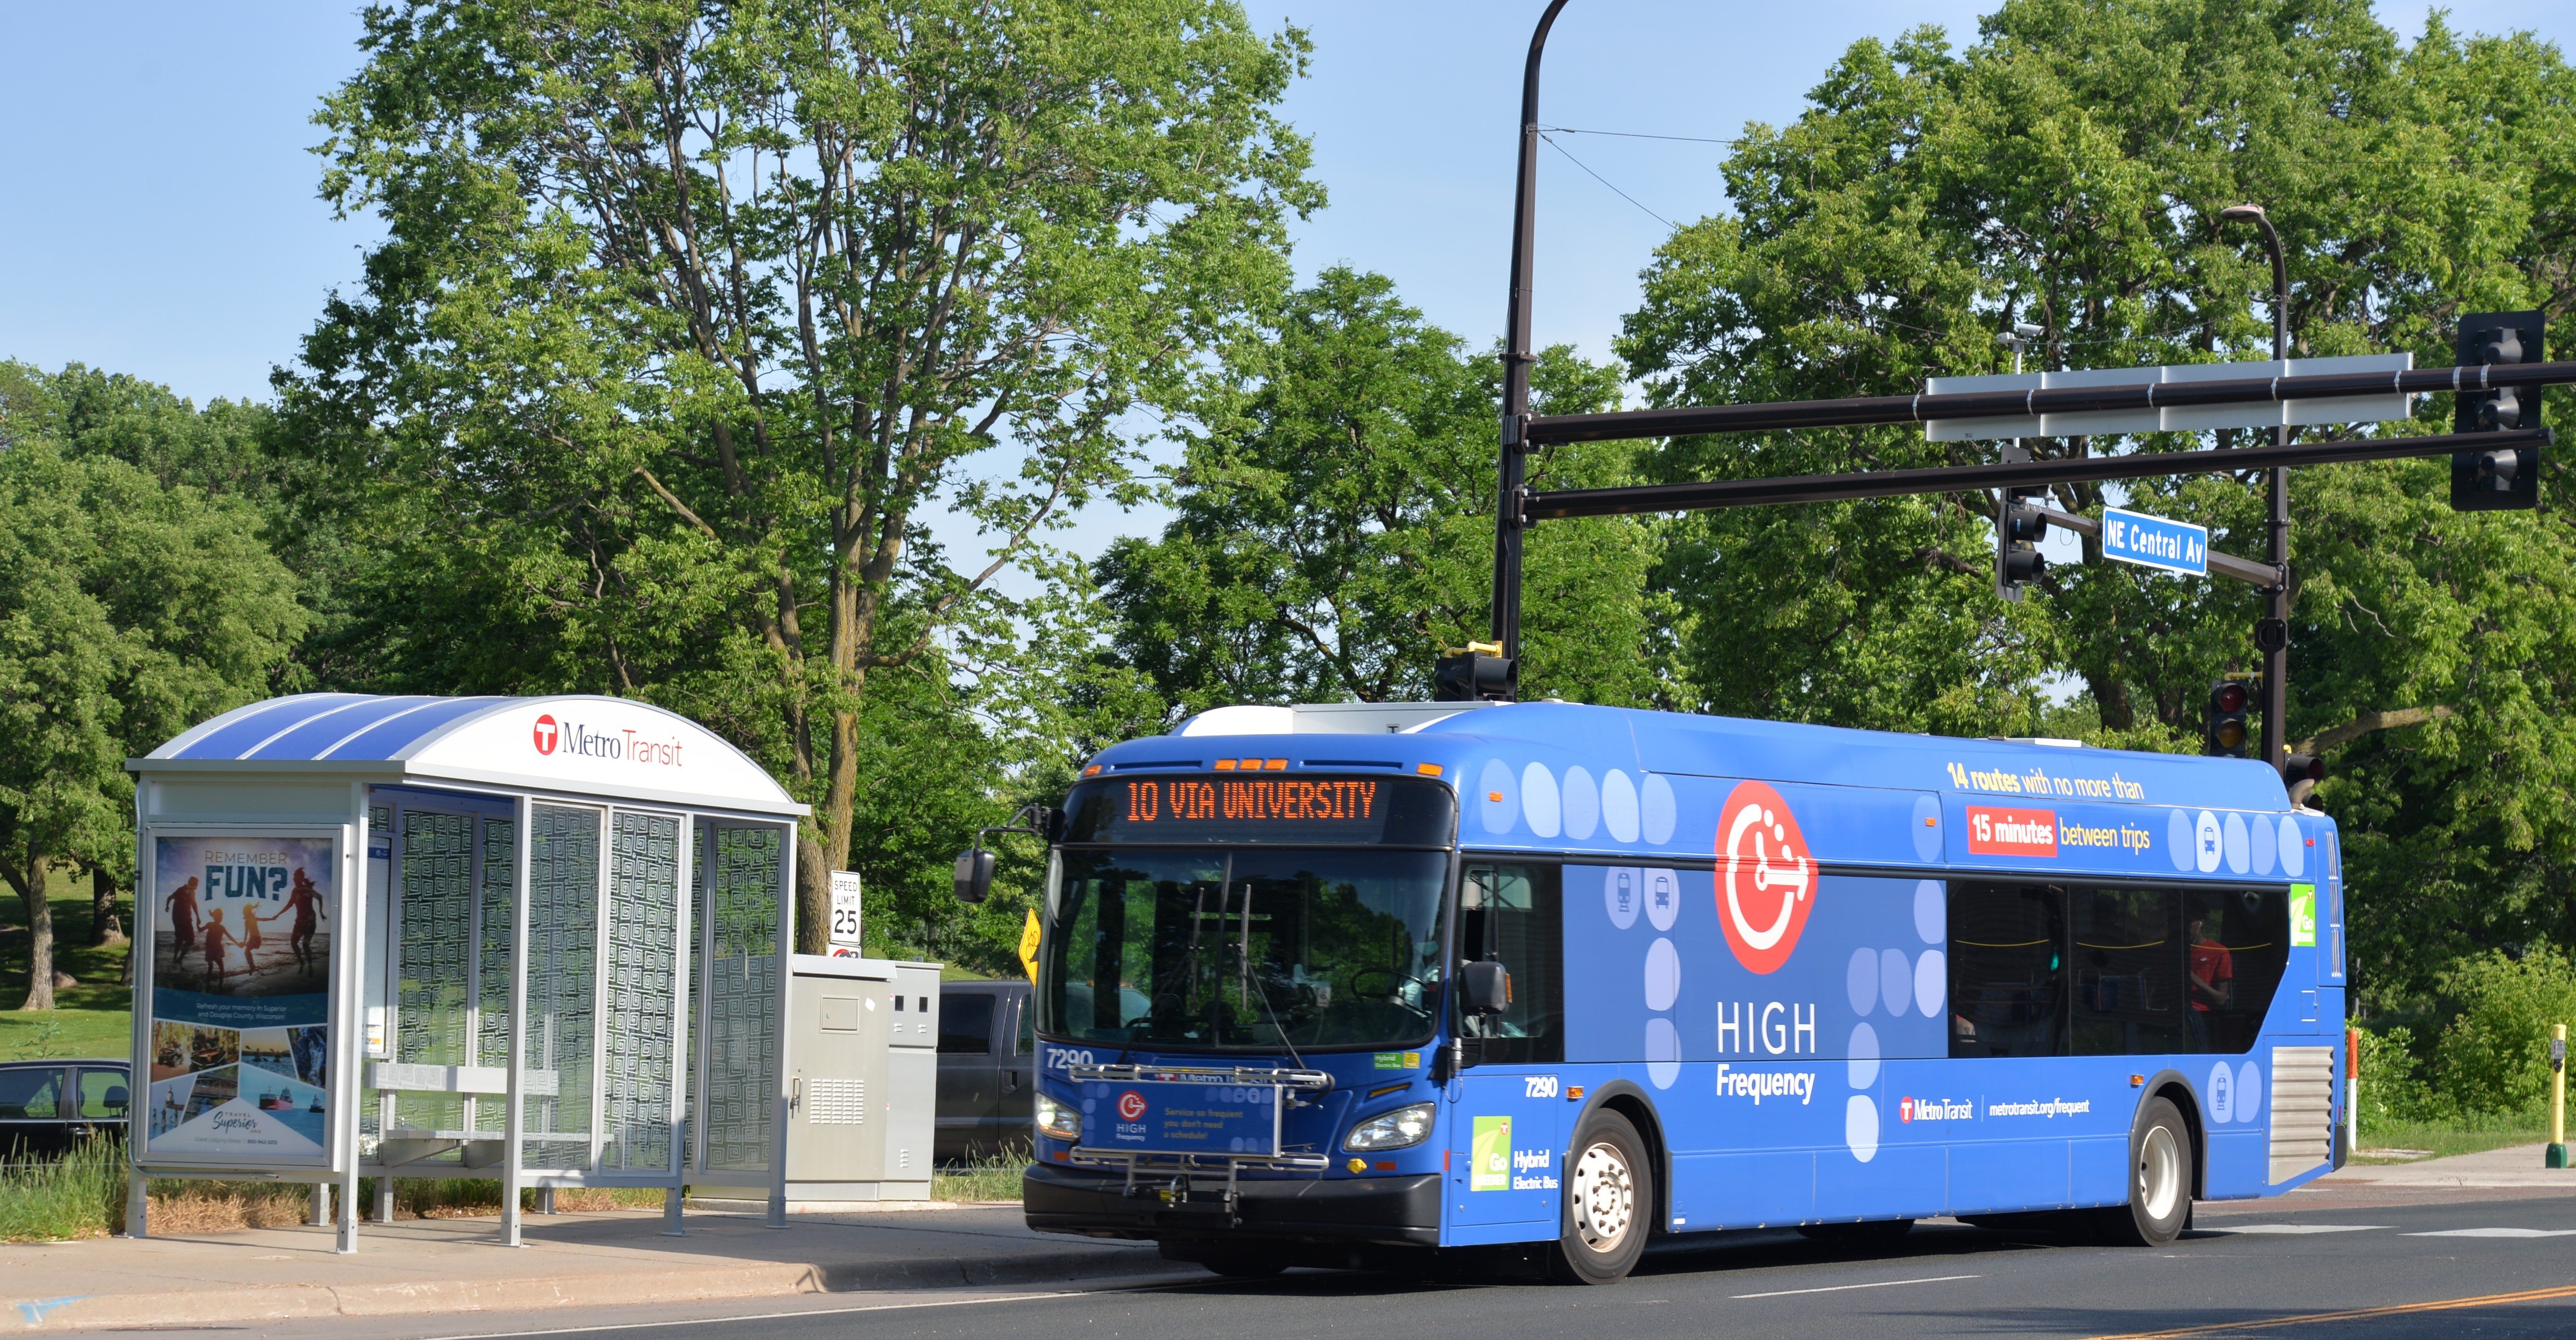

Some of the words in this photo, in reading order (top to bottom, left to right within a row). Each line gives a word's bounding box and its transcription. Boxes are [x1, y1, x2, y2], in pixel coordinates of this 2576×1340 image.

[2108, 519, 2125, 549] NE
[2131, 524, 2180, 560] Central
[2186, 536, 2203, 564] Av
[1947, 762, 1969, 789] 14
[1970, 769, 2021, 793] routes
[2021, 767, 2053, 794] with
[2054, 777, 2073, 796] no
[2074, 778, 2111, 798] more
[2112, 772, 2145, 800] than
[1127, 782, 1159, 821] 10
[1169, 782, 1215, 819] VIA
[1223, 781, 1376, 819] UNIVERSITY
[1972, 814, 1991, 842] 15
[1995, 815, 2053, 845] minutes
[2059, 816, 2118, 847] between
[2121, 822, 2150, 856] trips
[205, 850, 288, 864] REMEMBER
[205, 865, 288, 901] FUN?
[834, 880, 858, 892] SPEED
[837, 895, 855, 906] LIMIT
[834, 909, 857, 935] 25
[1717, 1001, 1815, 1055] HIGH
[1046, 1048, 1093, 1071] 7290
[1525, 1076, 1558, 1098] 7290
[1716, 1064, 1816, 1105] Frequency
[1165, 1107, 1194, 1116] Service
[1208, 1108, 1244, 1119] frequent
[1989, 1097, 2090, 1118] metrotransit.org/frequent
[212, 1111, 259, 1133] Superior
[1116, 1123, 1146, 1134] HIGH
[1164, 1120, 1179, 1129] you
[1181, 1119, 1201, 1128] don't
[1116, 1133, 1145, 1142] Frequency
[1171, 1130, 1208, 1139] schedule!
[1489, 1153, 1507, 1171] Go
[1513, 1149, 1550, 1173] Hybrid
[1513, 1176, 1542, 1190] Electric
[1543, 1175, 1559, 1189] Bus
